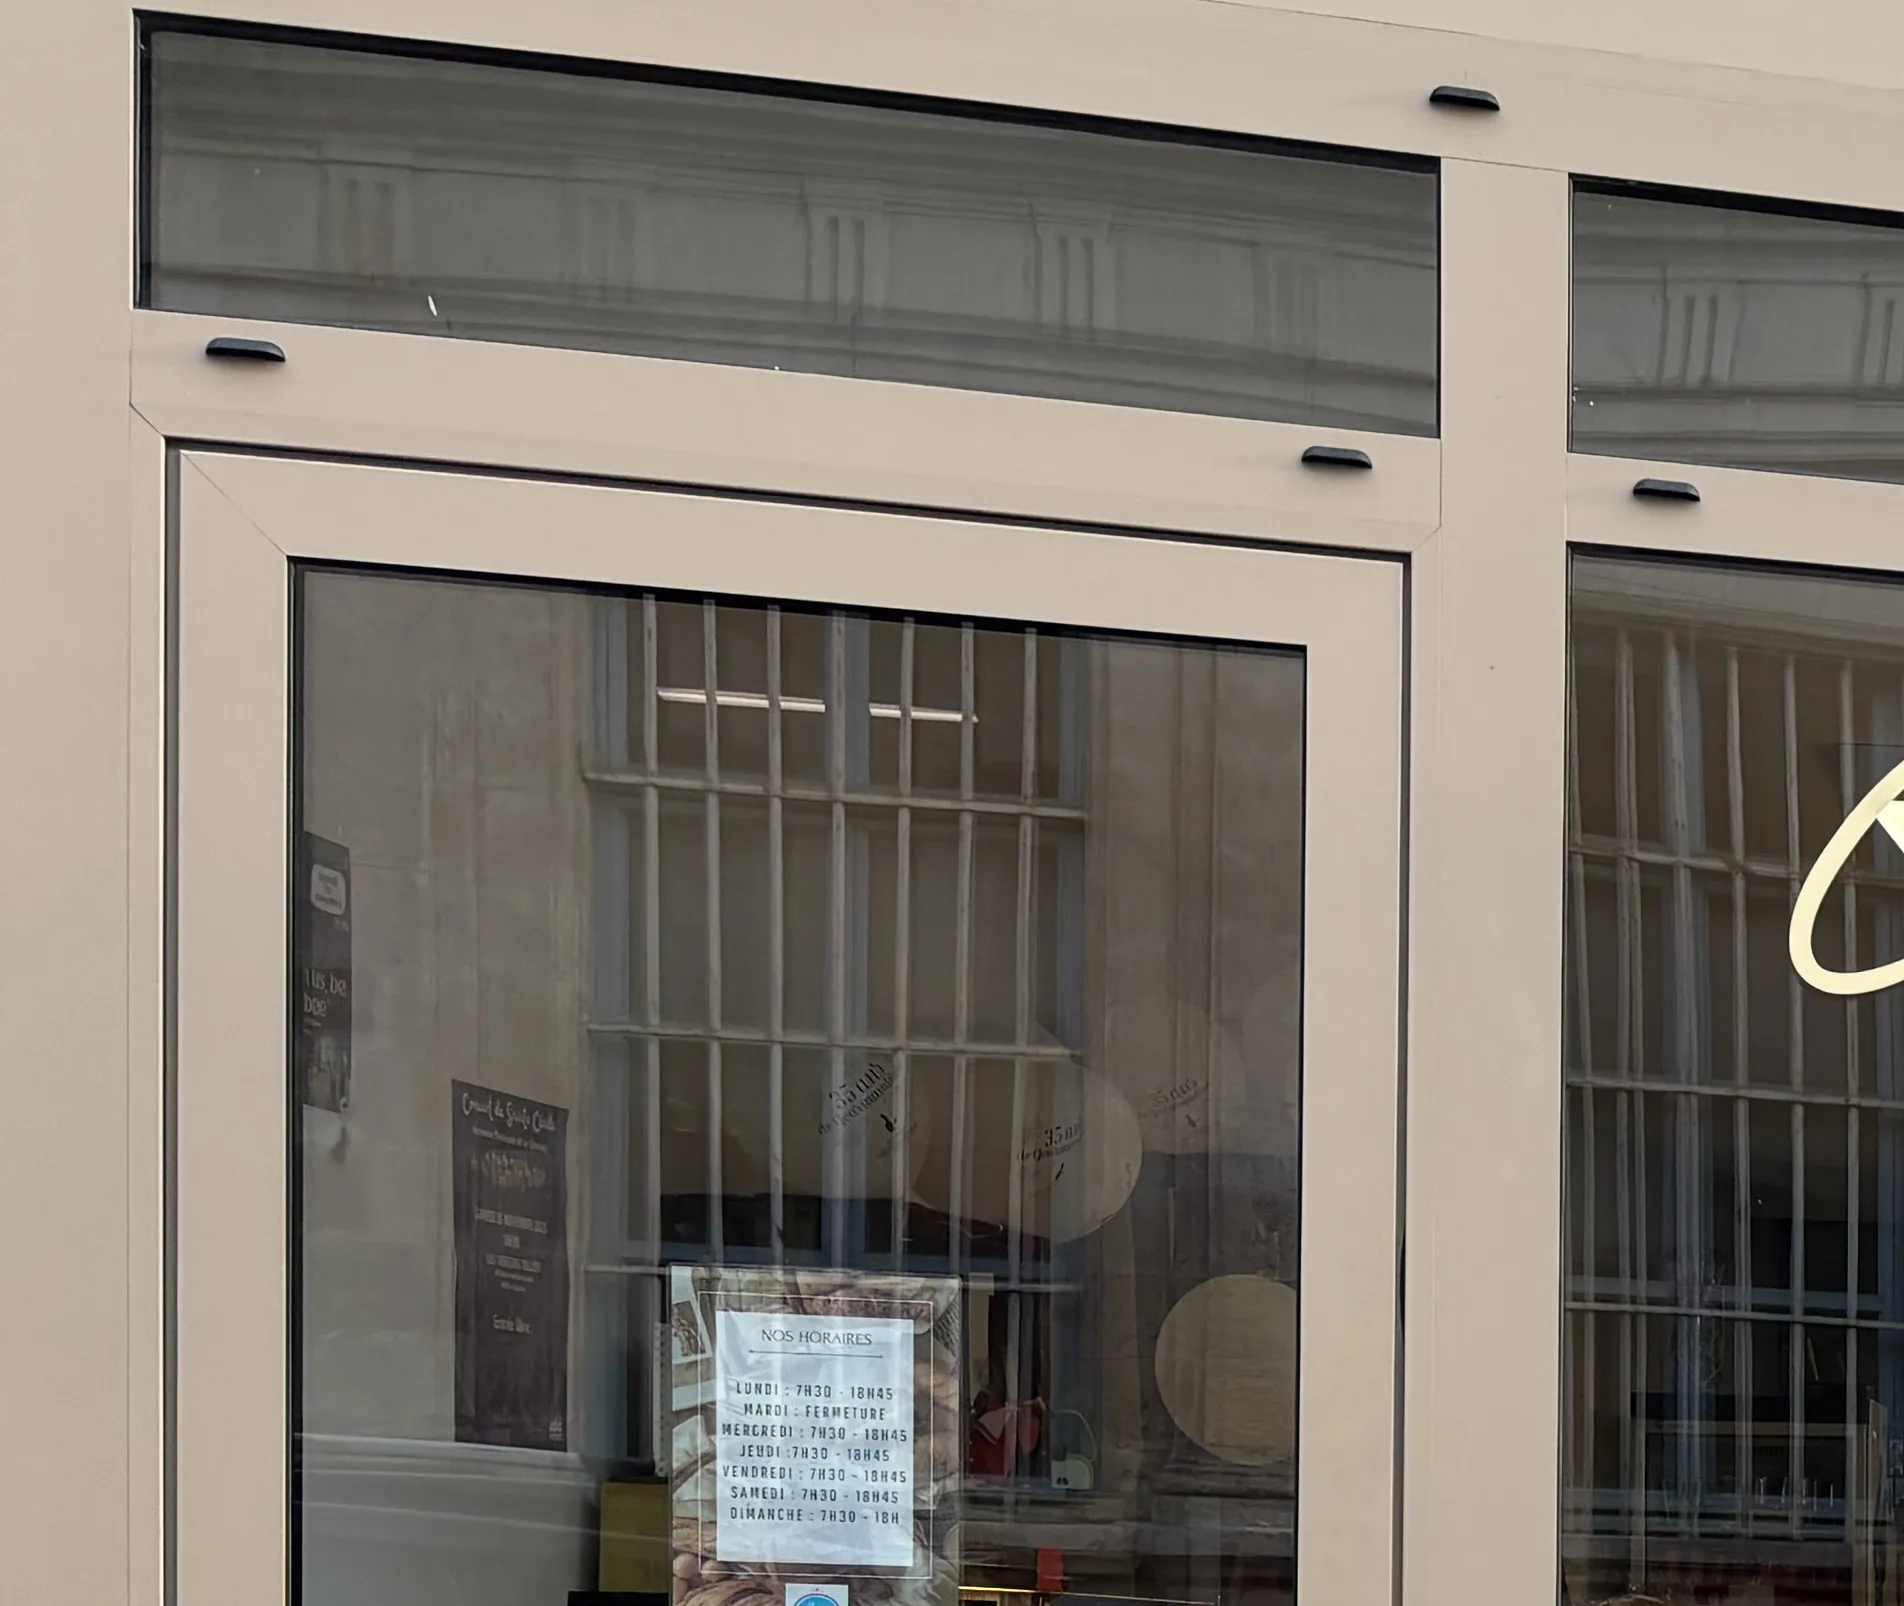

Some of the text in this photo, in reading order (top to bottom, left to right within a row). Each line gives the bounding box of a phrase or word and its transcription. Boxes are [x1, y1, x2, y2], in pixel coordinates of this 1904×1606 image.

[762, 1329, 873, 1346] NOS HORAIRES
[736, 1382, 778, 1396] LUNDI
[796, 1384, 832, 1398] 7H30
[850, 1386, 893, 1400] 18H45
[744, 1403, 788, 1416] MARDI
[805, 1405, 886, 1421] FERMETURE
[722, 1423, 793, 1438] MERCREDI
[810, 1426, 846, 1440] 7H30
[864, 1428, 908, 1442] 18H45
[739, 1444, 780, 1458] JEUDI
[847, 1448, 890, 1462] 18H45
[722, 1465, 793, 1480] VENDREDI
[810, 1468, 846, 1481] 7H30
[864, 1470, 907, 1483] 18H45
[730, 1486, 784, 1500] SAMEDI
[801, 1488, 837, 1501] 7H30
[856, 1490, 899, 1504] 18H45
[730, 1506, 803, 1521] DIMANCHE
[820, 1509, 856, 1523] 7H30
[875, 1511, 900, 1525] 18H
